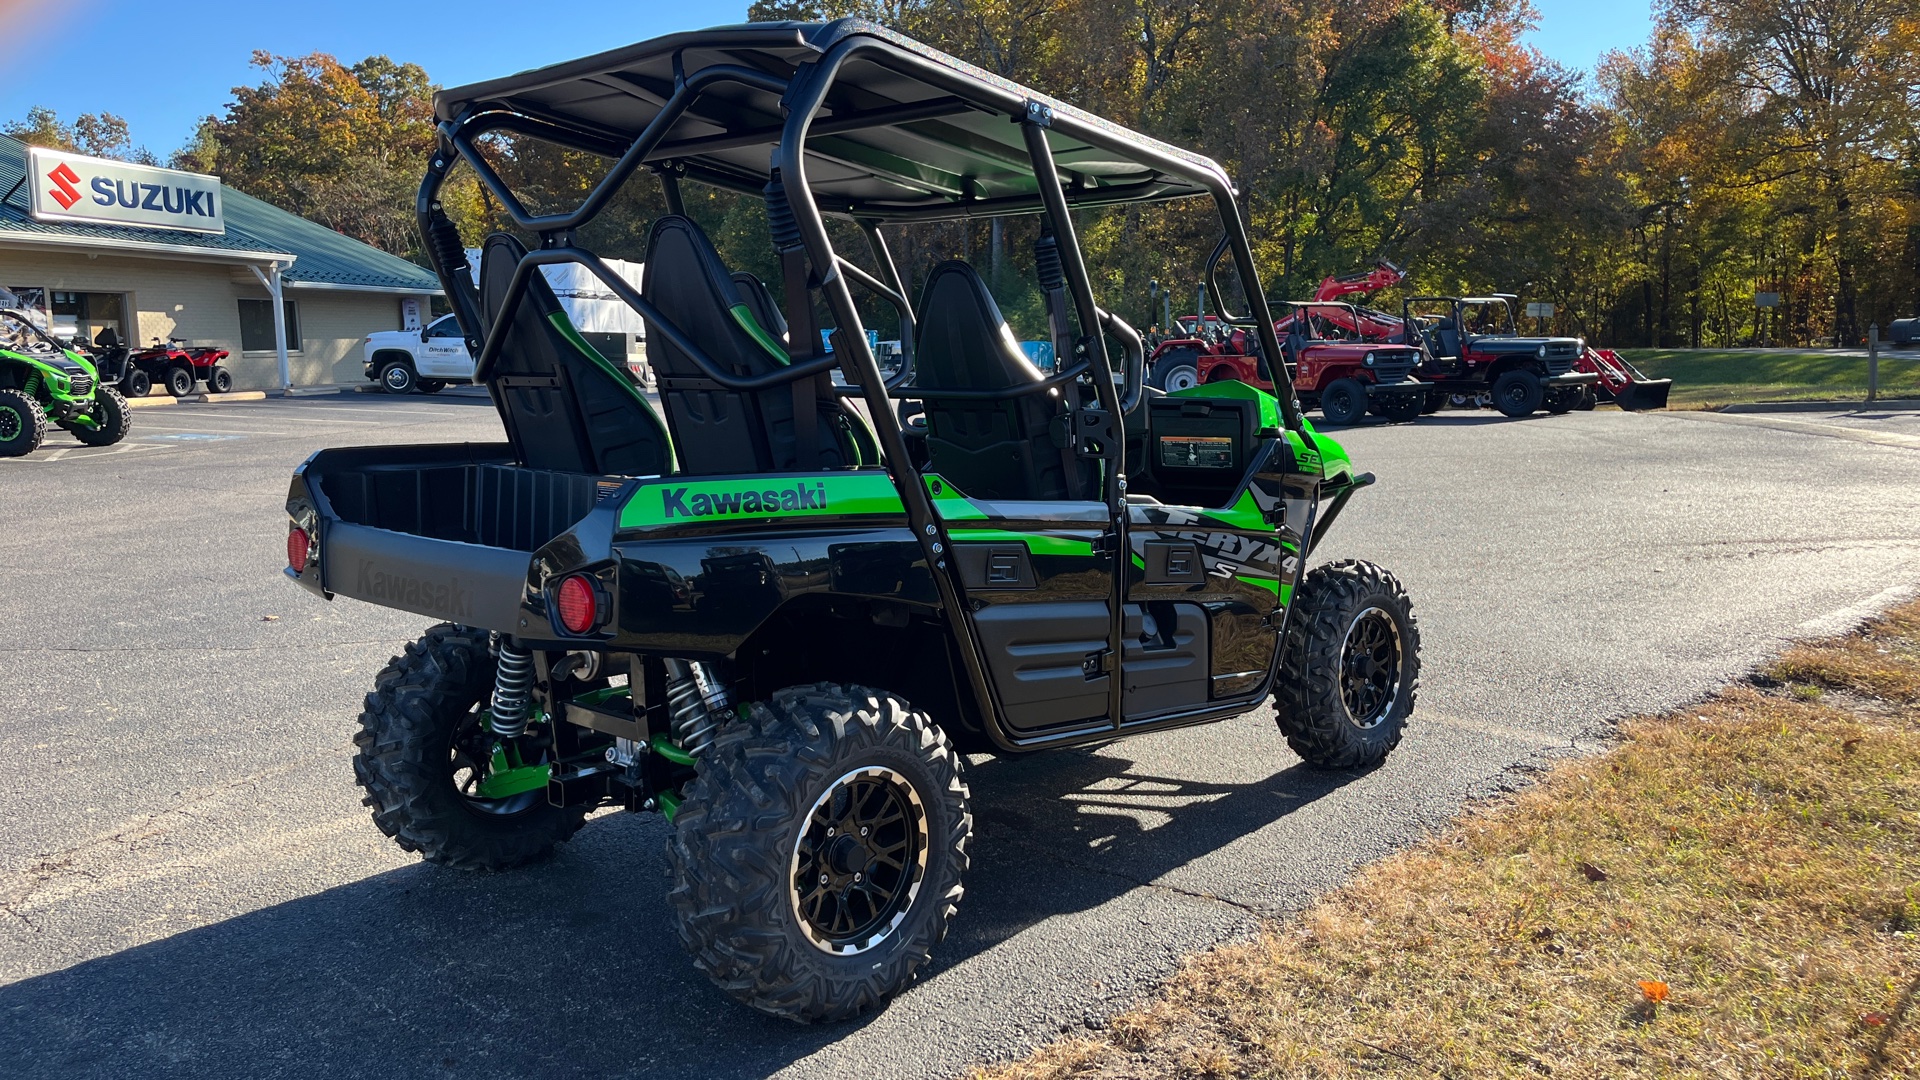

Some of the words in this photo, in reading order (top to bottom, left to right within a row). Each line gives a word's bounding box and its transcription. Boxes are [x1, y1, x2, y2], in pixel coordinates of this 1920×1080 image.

[91, 175, 215, 218] SUZUKI
[1296, 452, 1321, 466] SE
[661, 482, 827, 518] Kawasaki
[356, 558, 476, 618] Kawasaki
[1208, 562, 1238, 579] S
